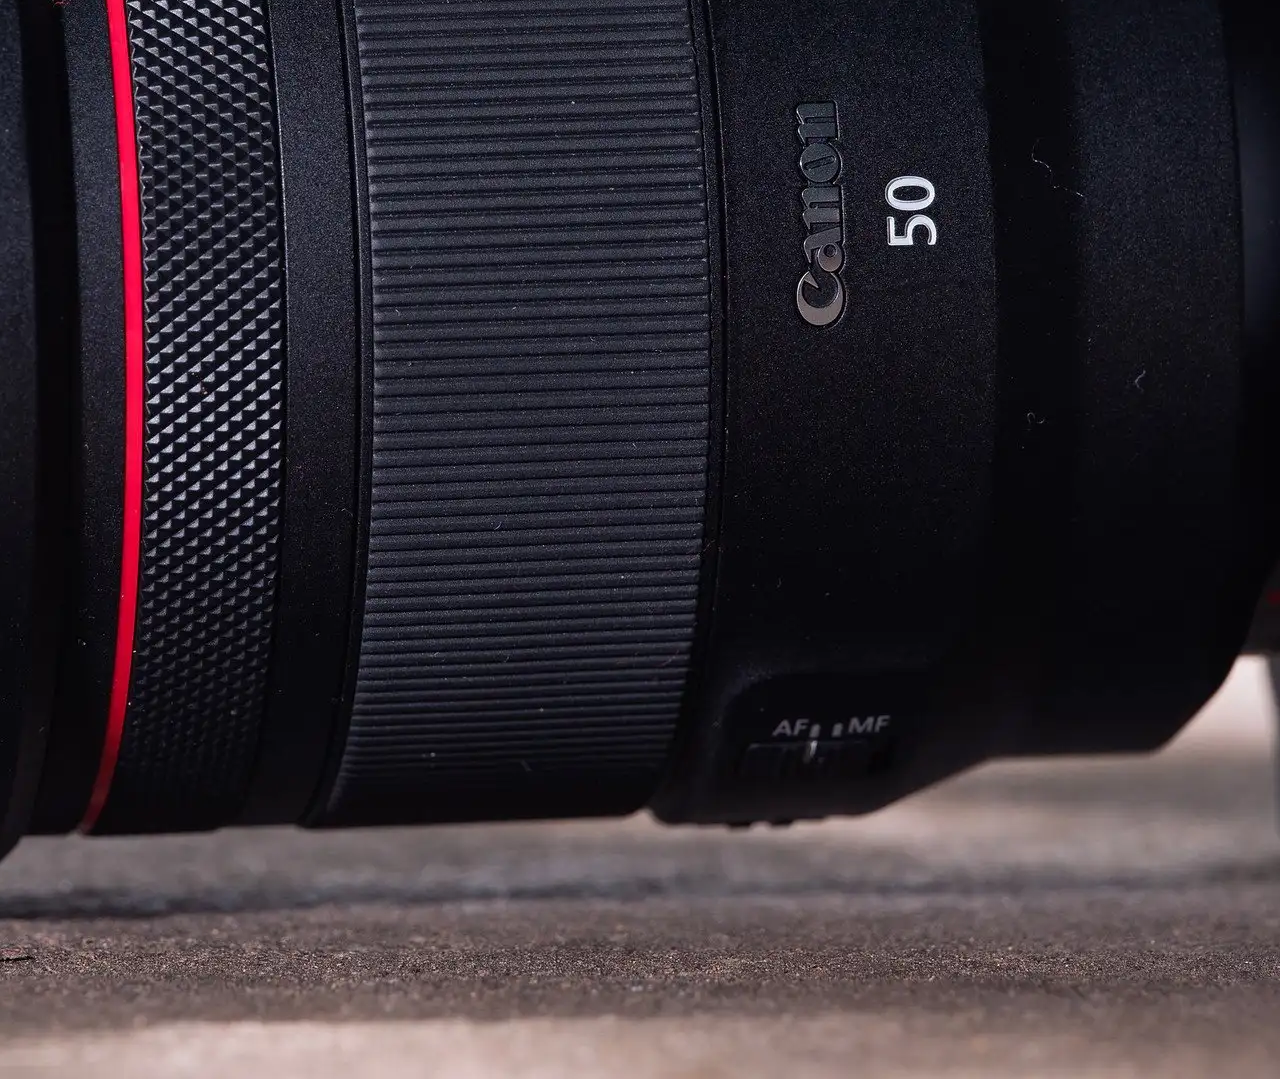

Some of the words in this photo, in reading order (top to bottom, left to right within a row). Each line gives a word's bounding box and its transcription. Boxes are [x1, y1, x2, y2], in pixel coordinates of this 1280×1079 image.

[795, 100, 847, 327] Canon
[884, 174, 938, 247] 50
[772, 718, 810, 737] AF
[847, 714, 891, 734] MF
